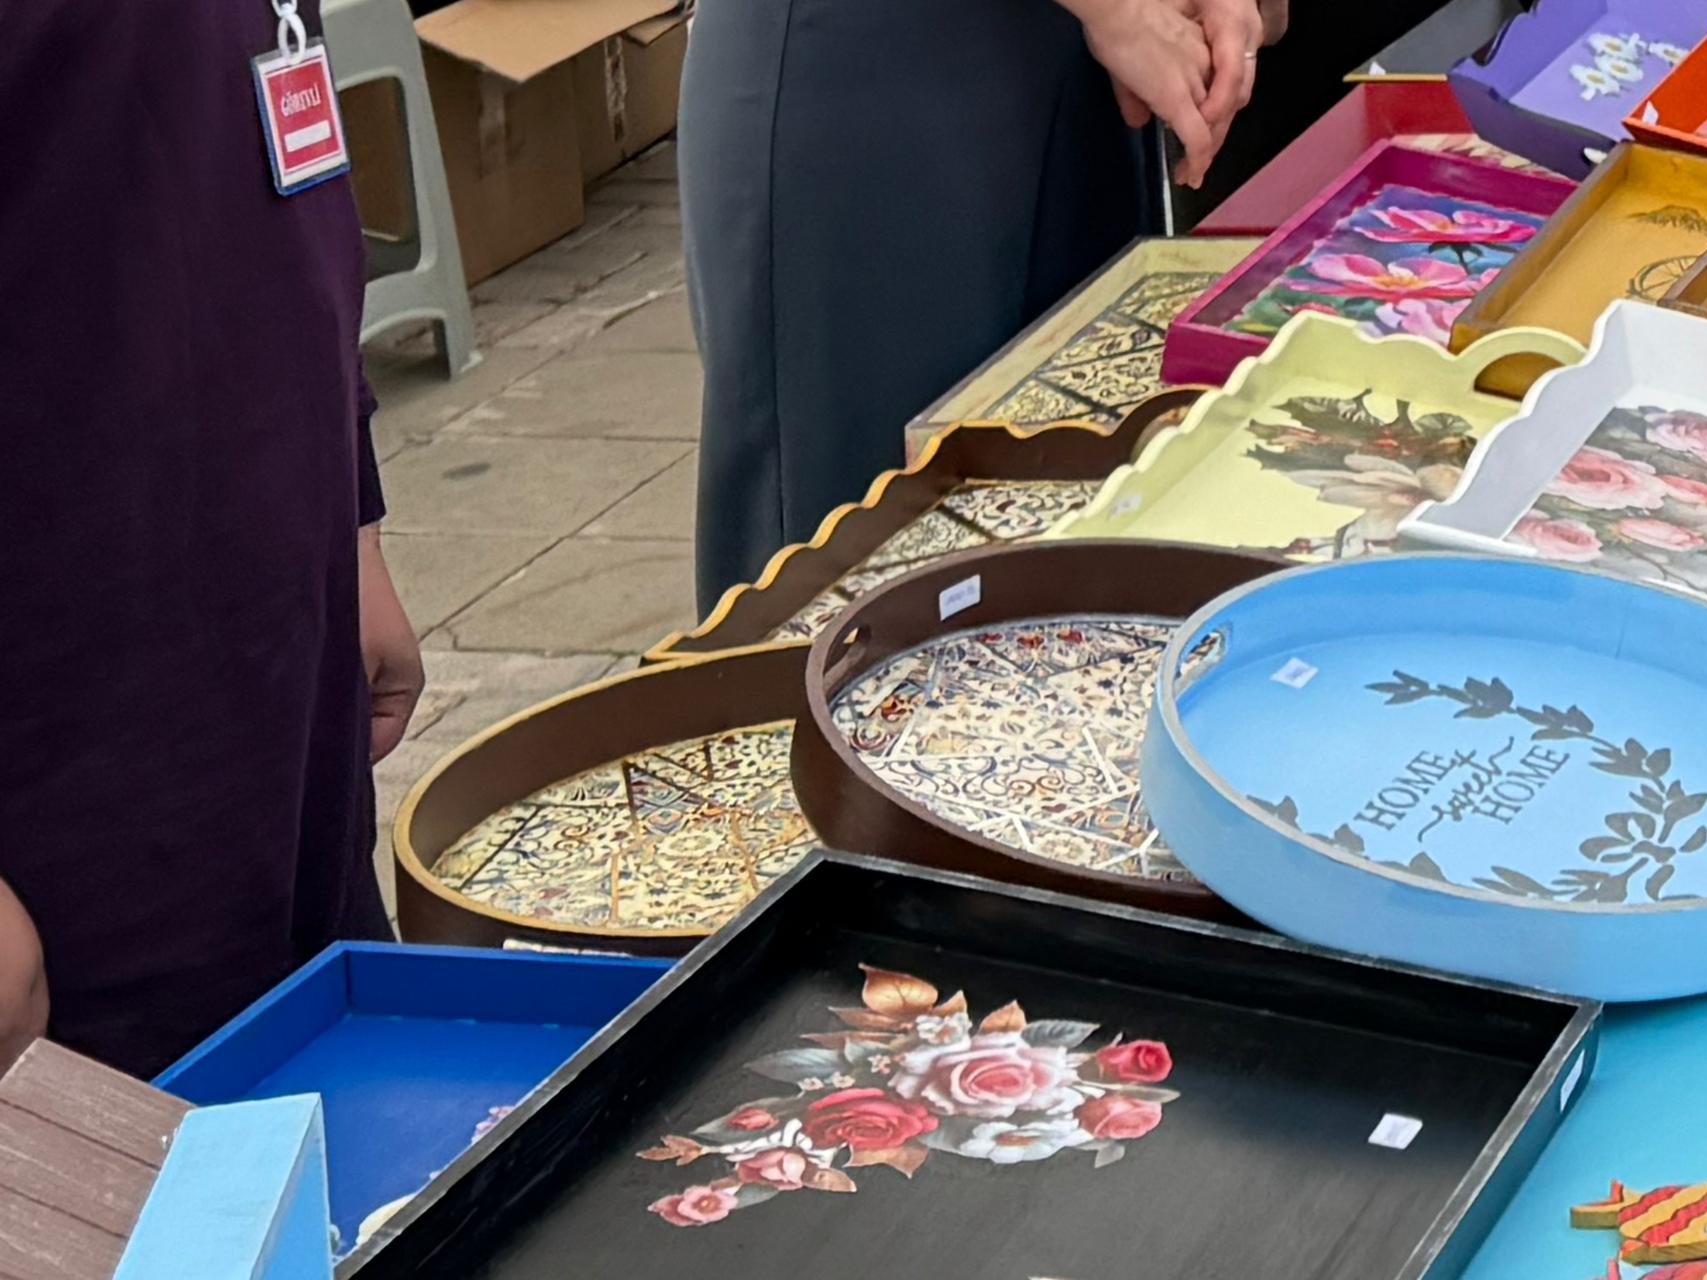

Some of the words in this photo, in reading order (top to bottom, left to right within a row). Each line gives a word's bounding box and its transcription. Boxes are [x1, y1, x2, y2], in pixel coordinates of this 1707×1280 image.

[1353, 750, 1457, 831] HOME
[1418, 736, 1514, 842] sweet
[1471, 745, 1570, 825] HOME
